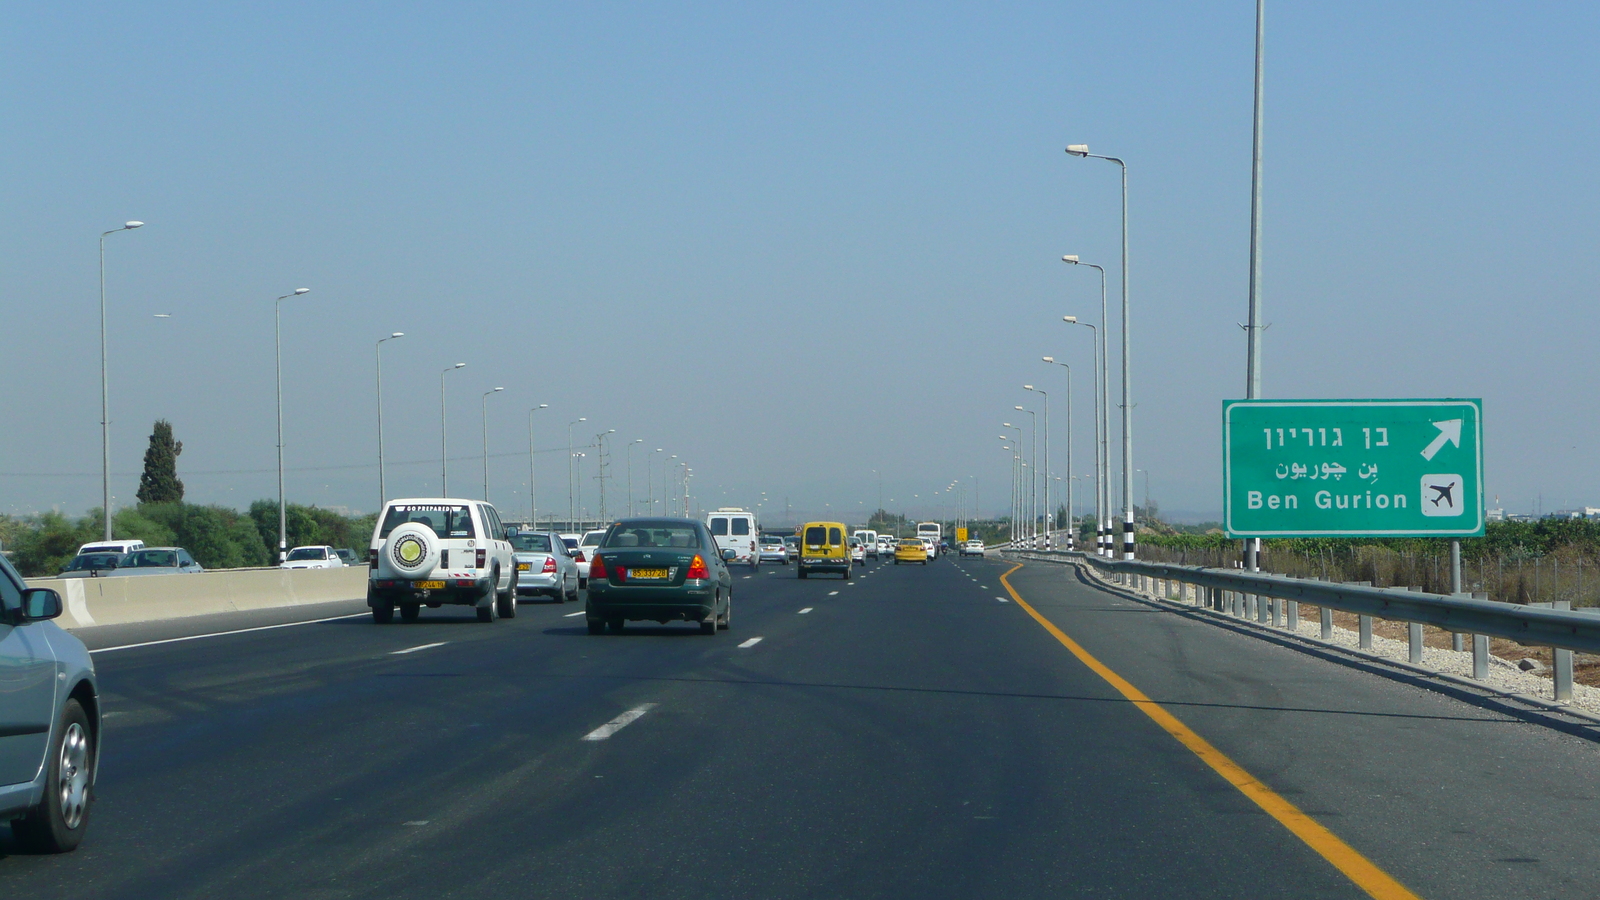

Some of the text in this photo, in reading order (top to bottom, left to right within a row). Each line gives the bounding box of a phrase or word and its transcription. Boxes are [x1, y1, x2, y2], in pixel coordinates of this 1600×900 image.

[1263, 427, 1389, 450] בן גוריון
[1247, 490, 1407, 509] Ben Gurion
